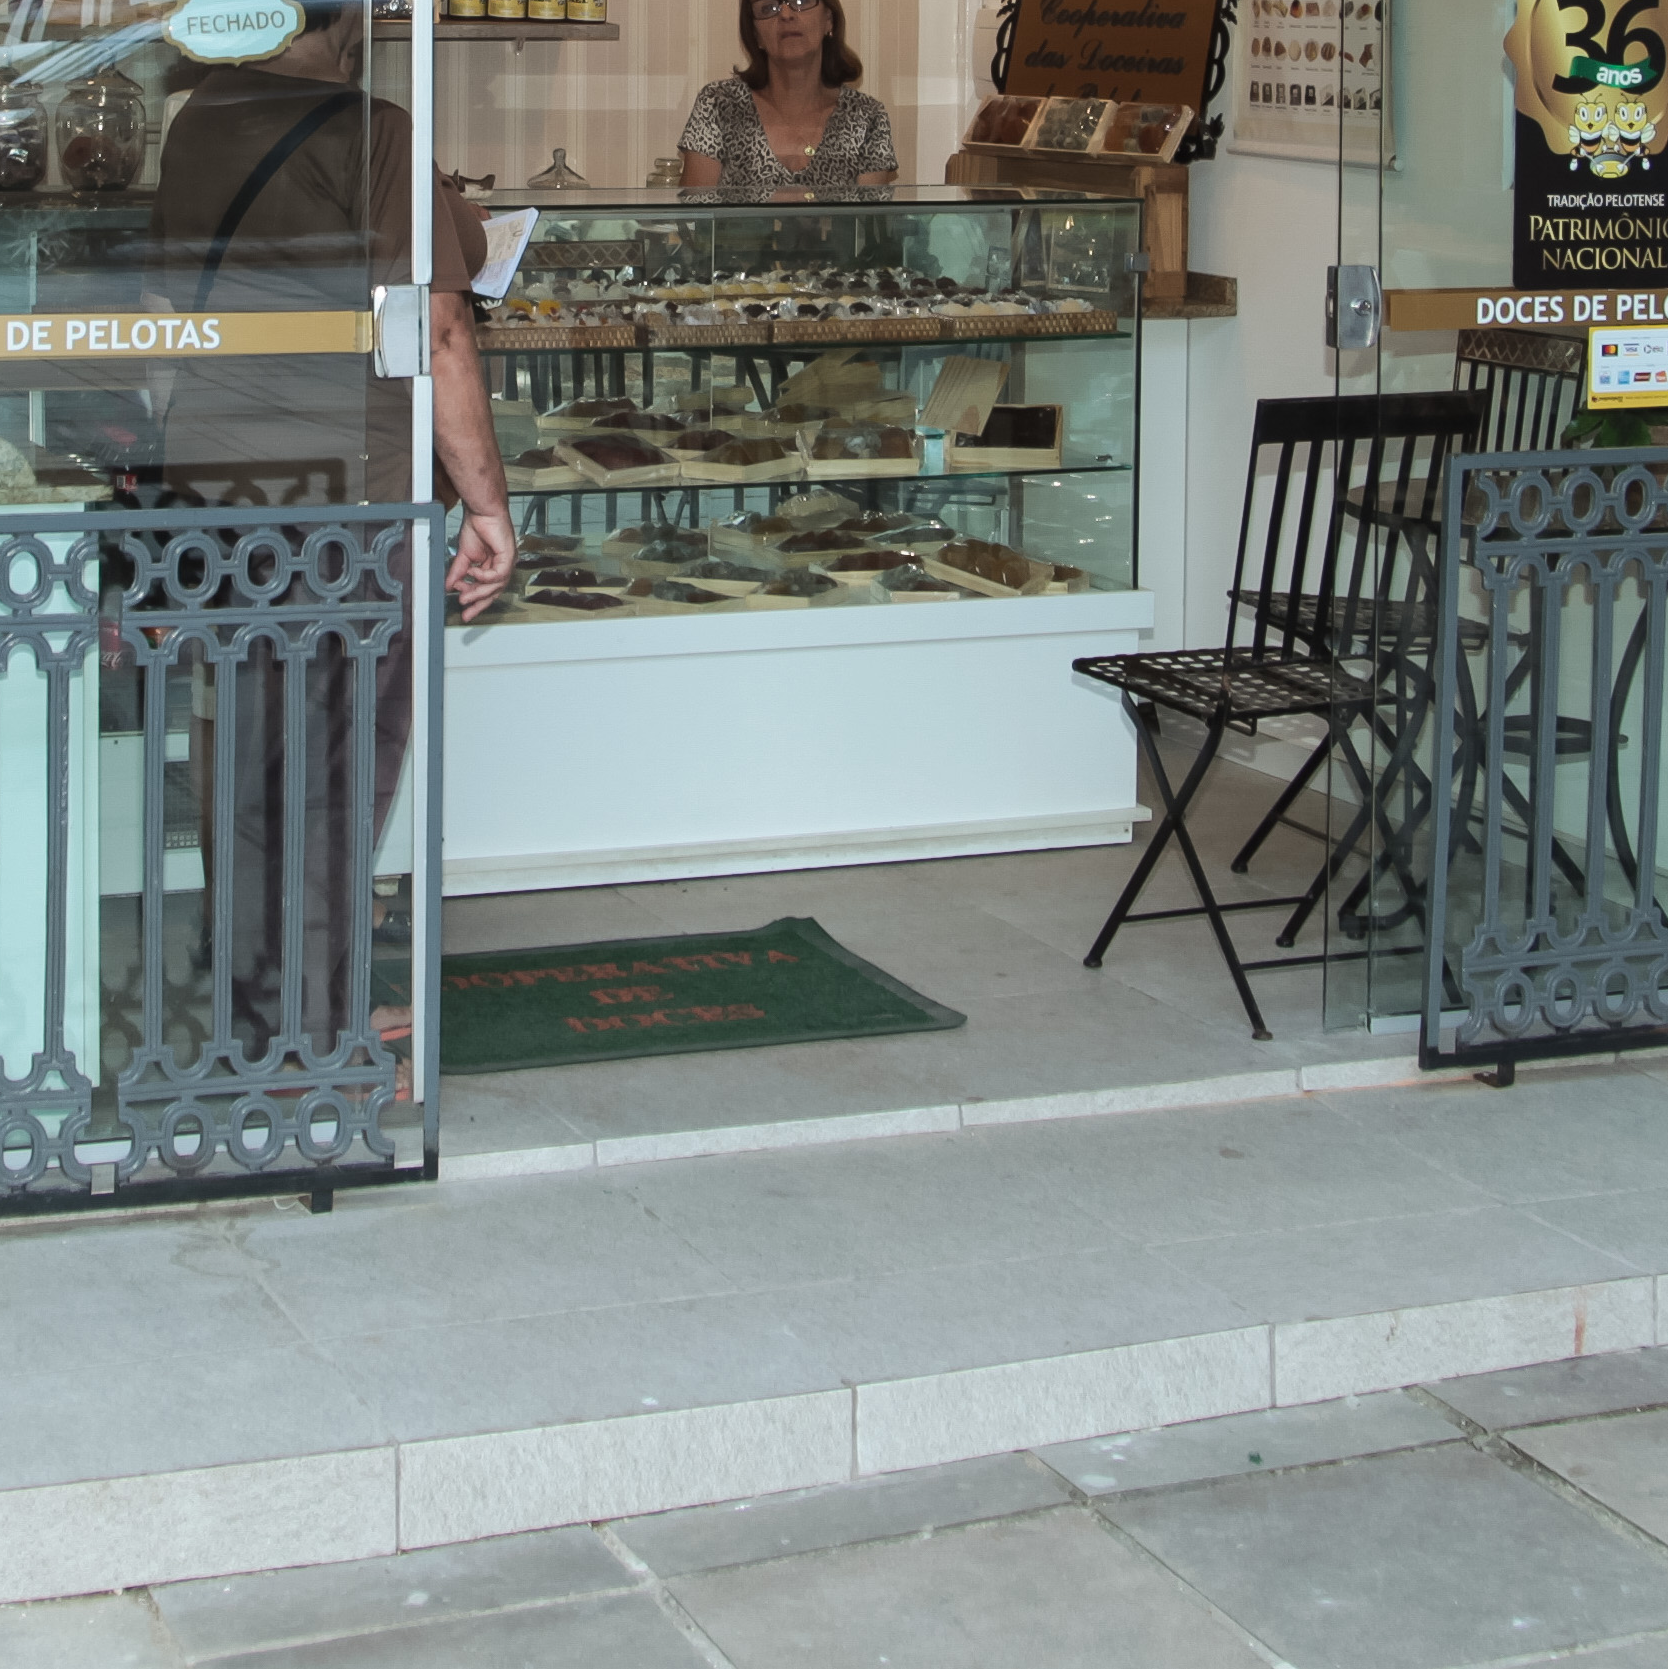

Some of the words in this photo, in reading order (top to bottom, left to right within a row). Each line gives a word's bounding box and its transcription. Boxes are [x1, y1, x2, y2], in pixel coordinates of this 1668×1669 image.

[186, 8, 286, 36] FECHADO
[1024, 38, 1073, 69] das
[1596, 65, 1643, 87] anos
[1547, 193, 1604, 210] TRADIÇÃO
[1605, 193, 1666, 208] PELOTENSE
[1542, 246, 1668, 271] NACIONAL
[1476, 295, 1564, 325] DOCES
[1573, 294, 1607, 322] DE
[6, 320, 52, 352] DE
[66, 318, 221, 351] PELOTAS
